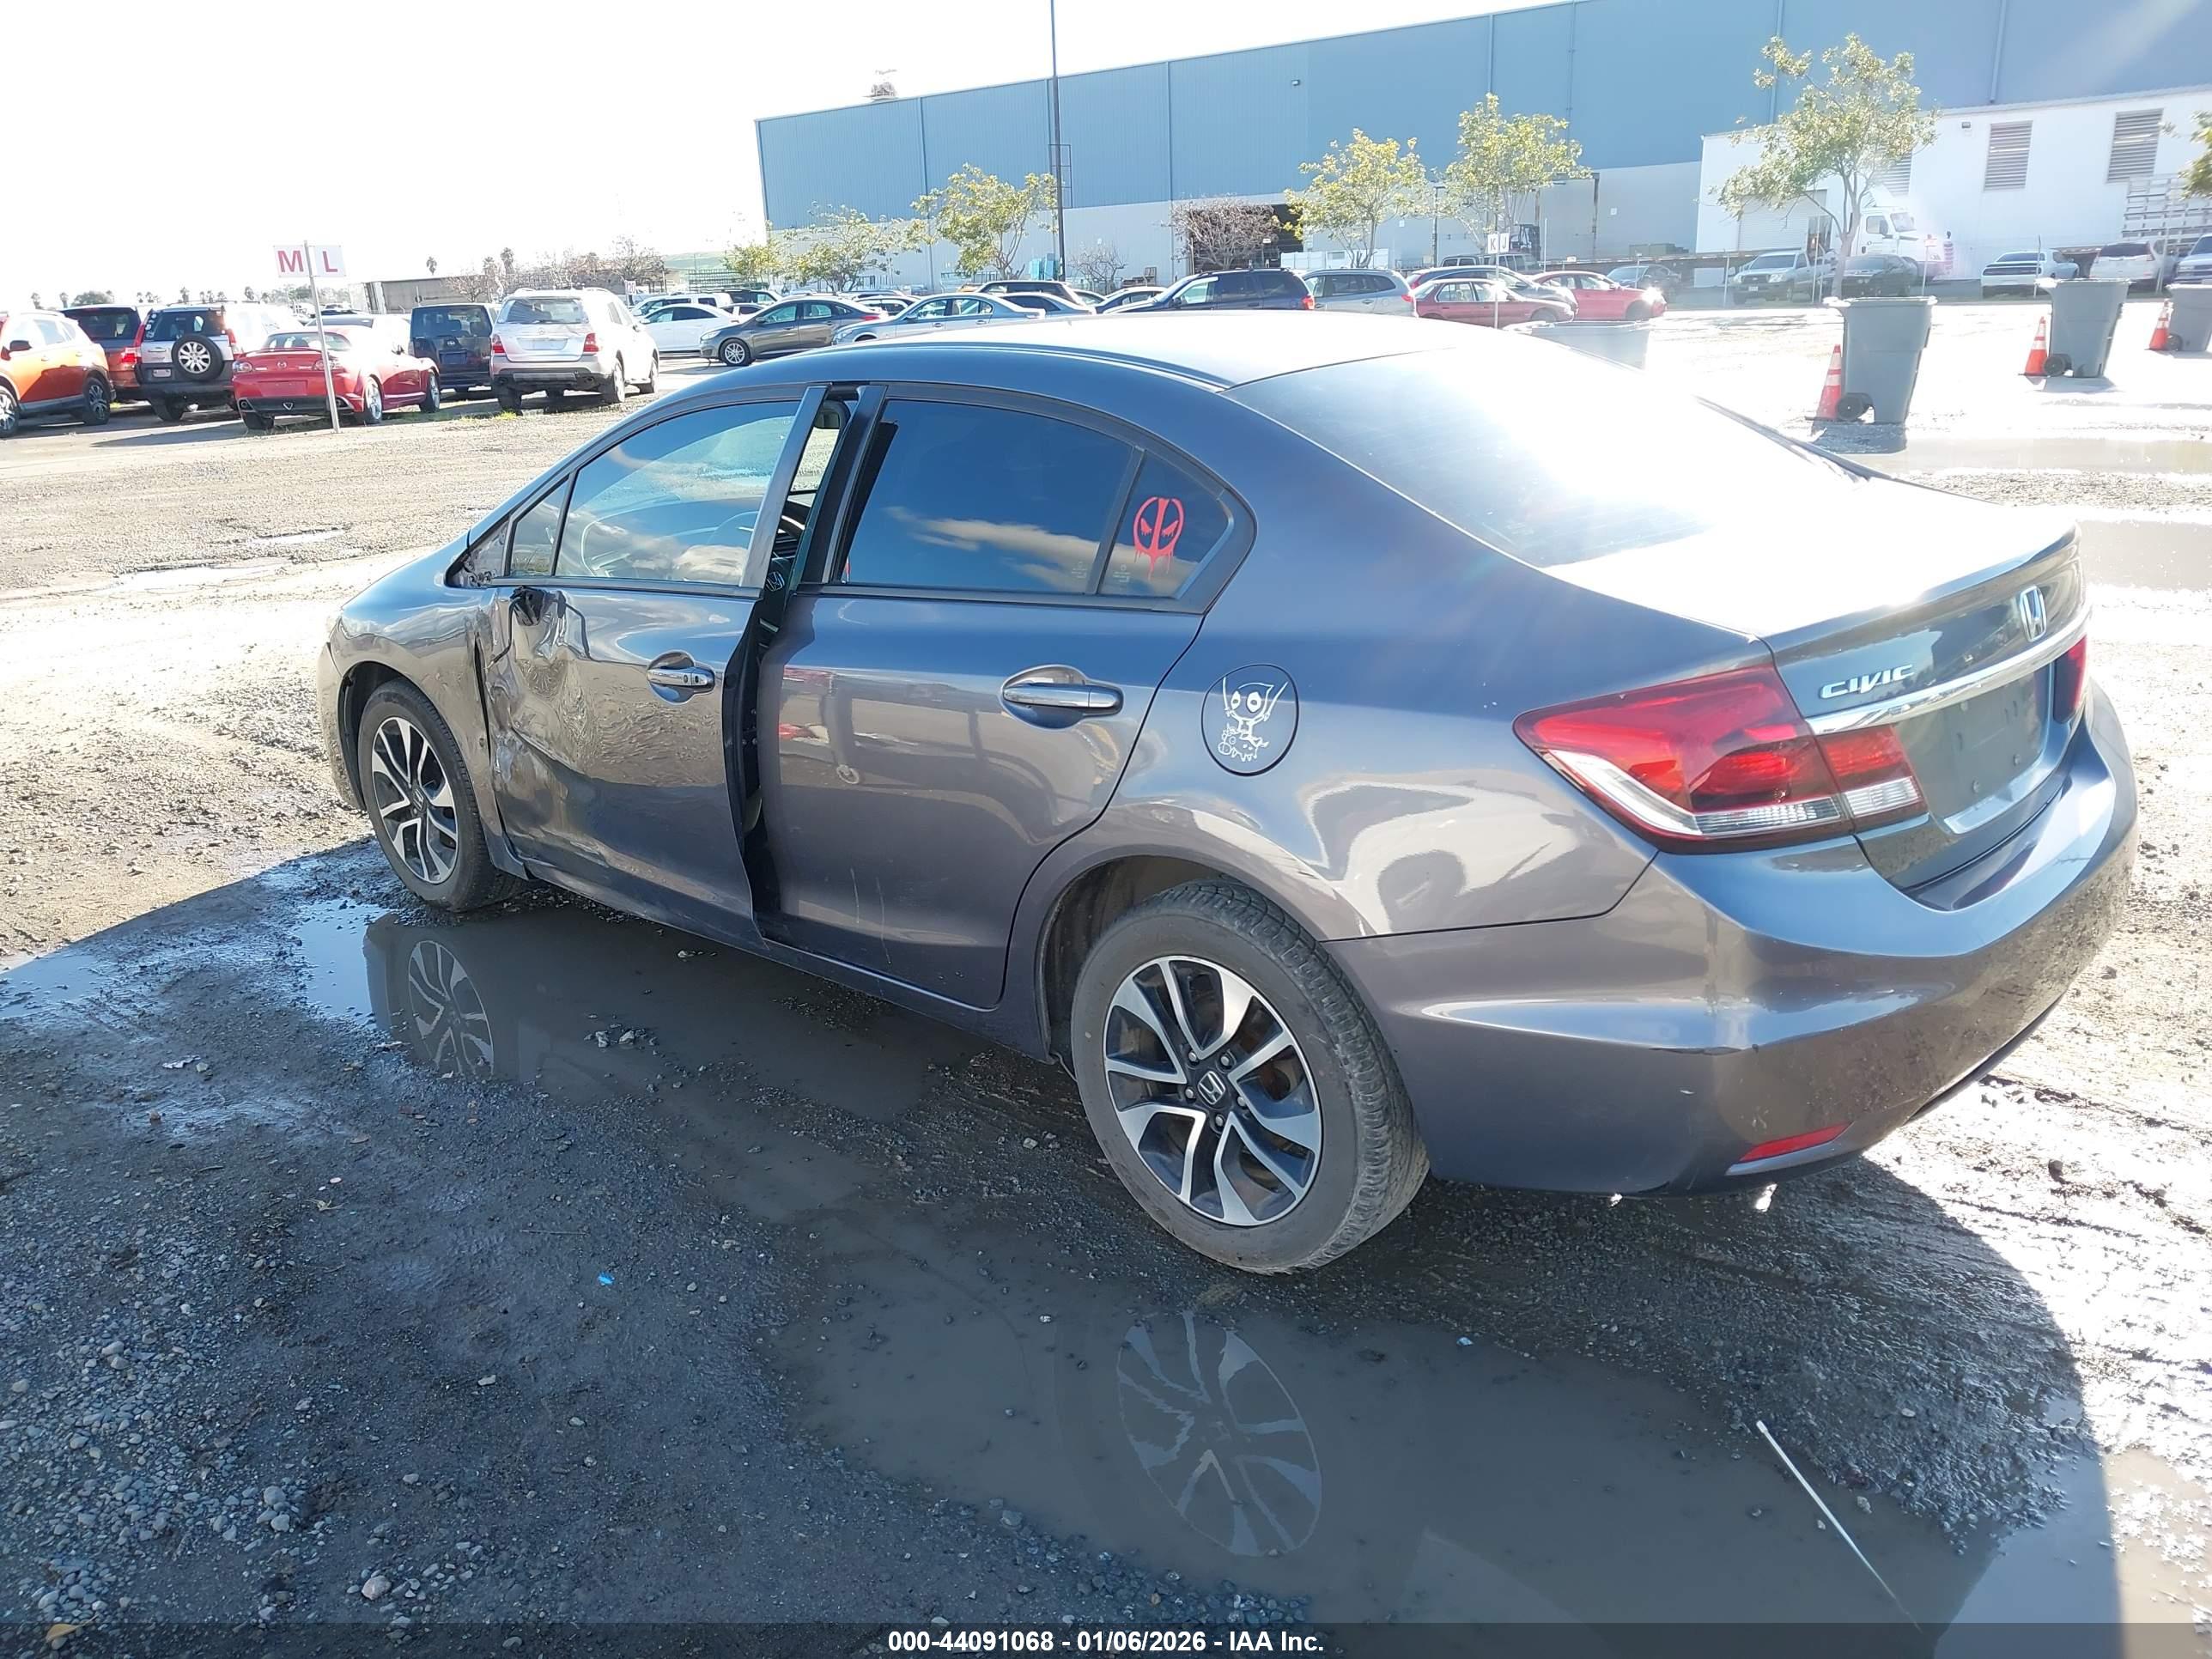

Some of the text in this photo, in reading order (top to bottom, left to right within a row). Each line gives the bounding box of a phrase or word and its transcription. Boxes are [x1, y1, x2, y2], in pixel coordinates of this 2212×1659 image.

[1490, 237, 1497, 251] K
[277, 250, 304, 272] M
[322, 251, 338, 272] L
[1821, 663, 1915, 699] CIVIC
